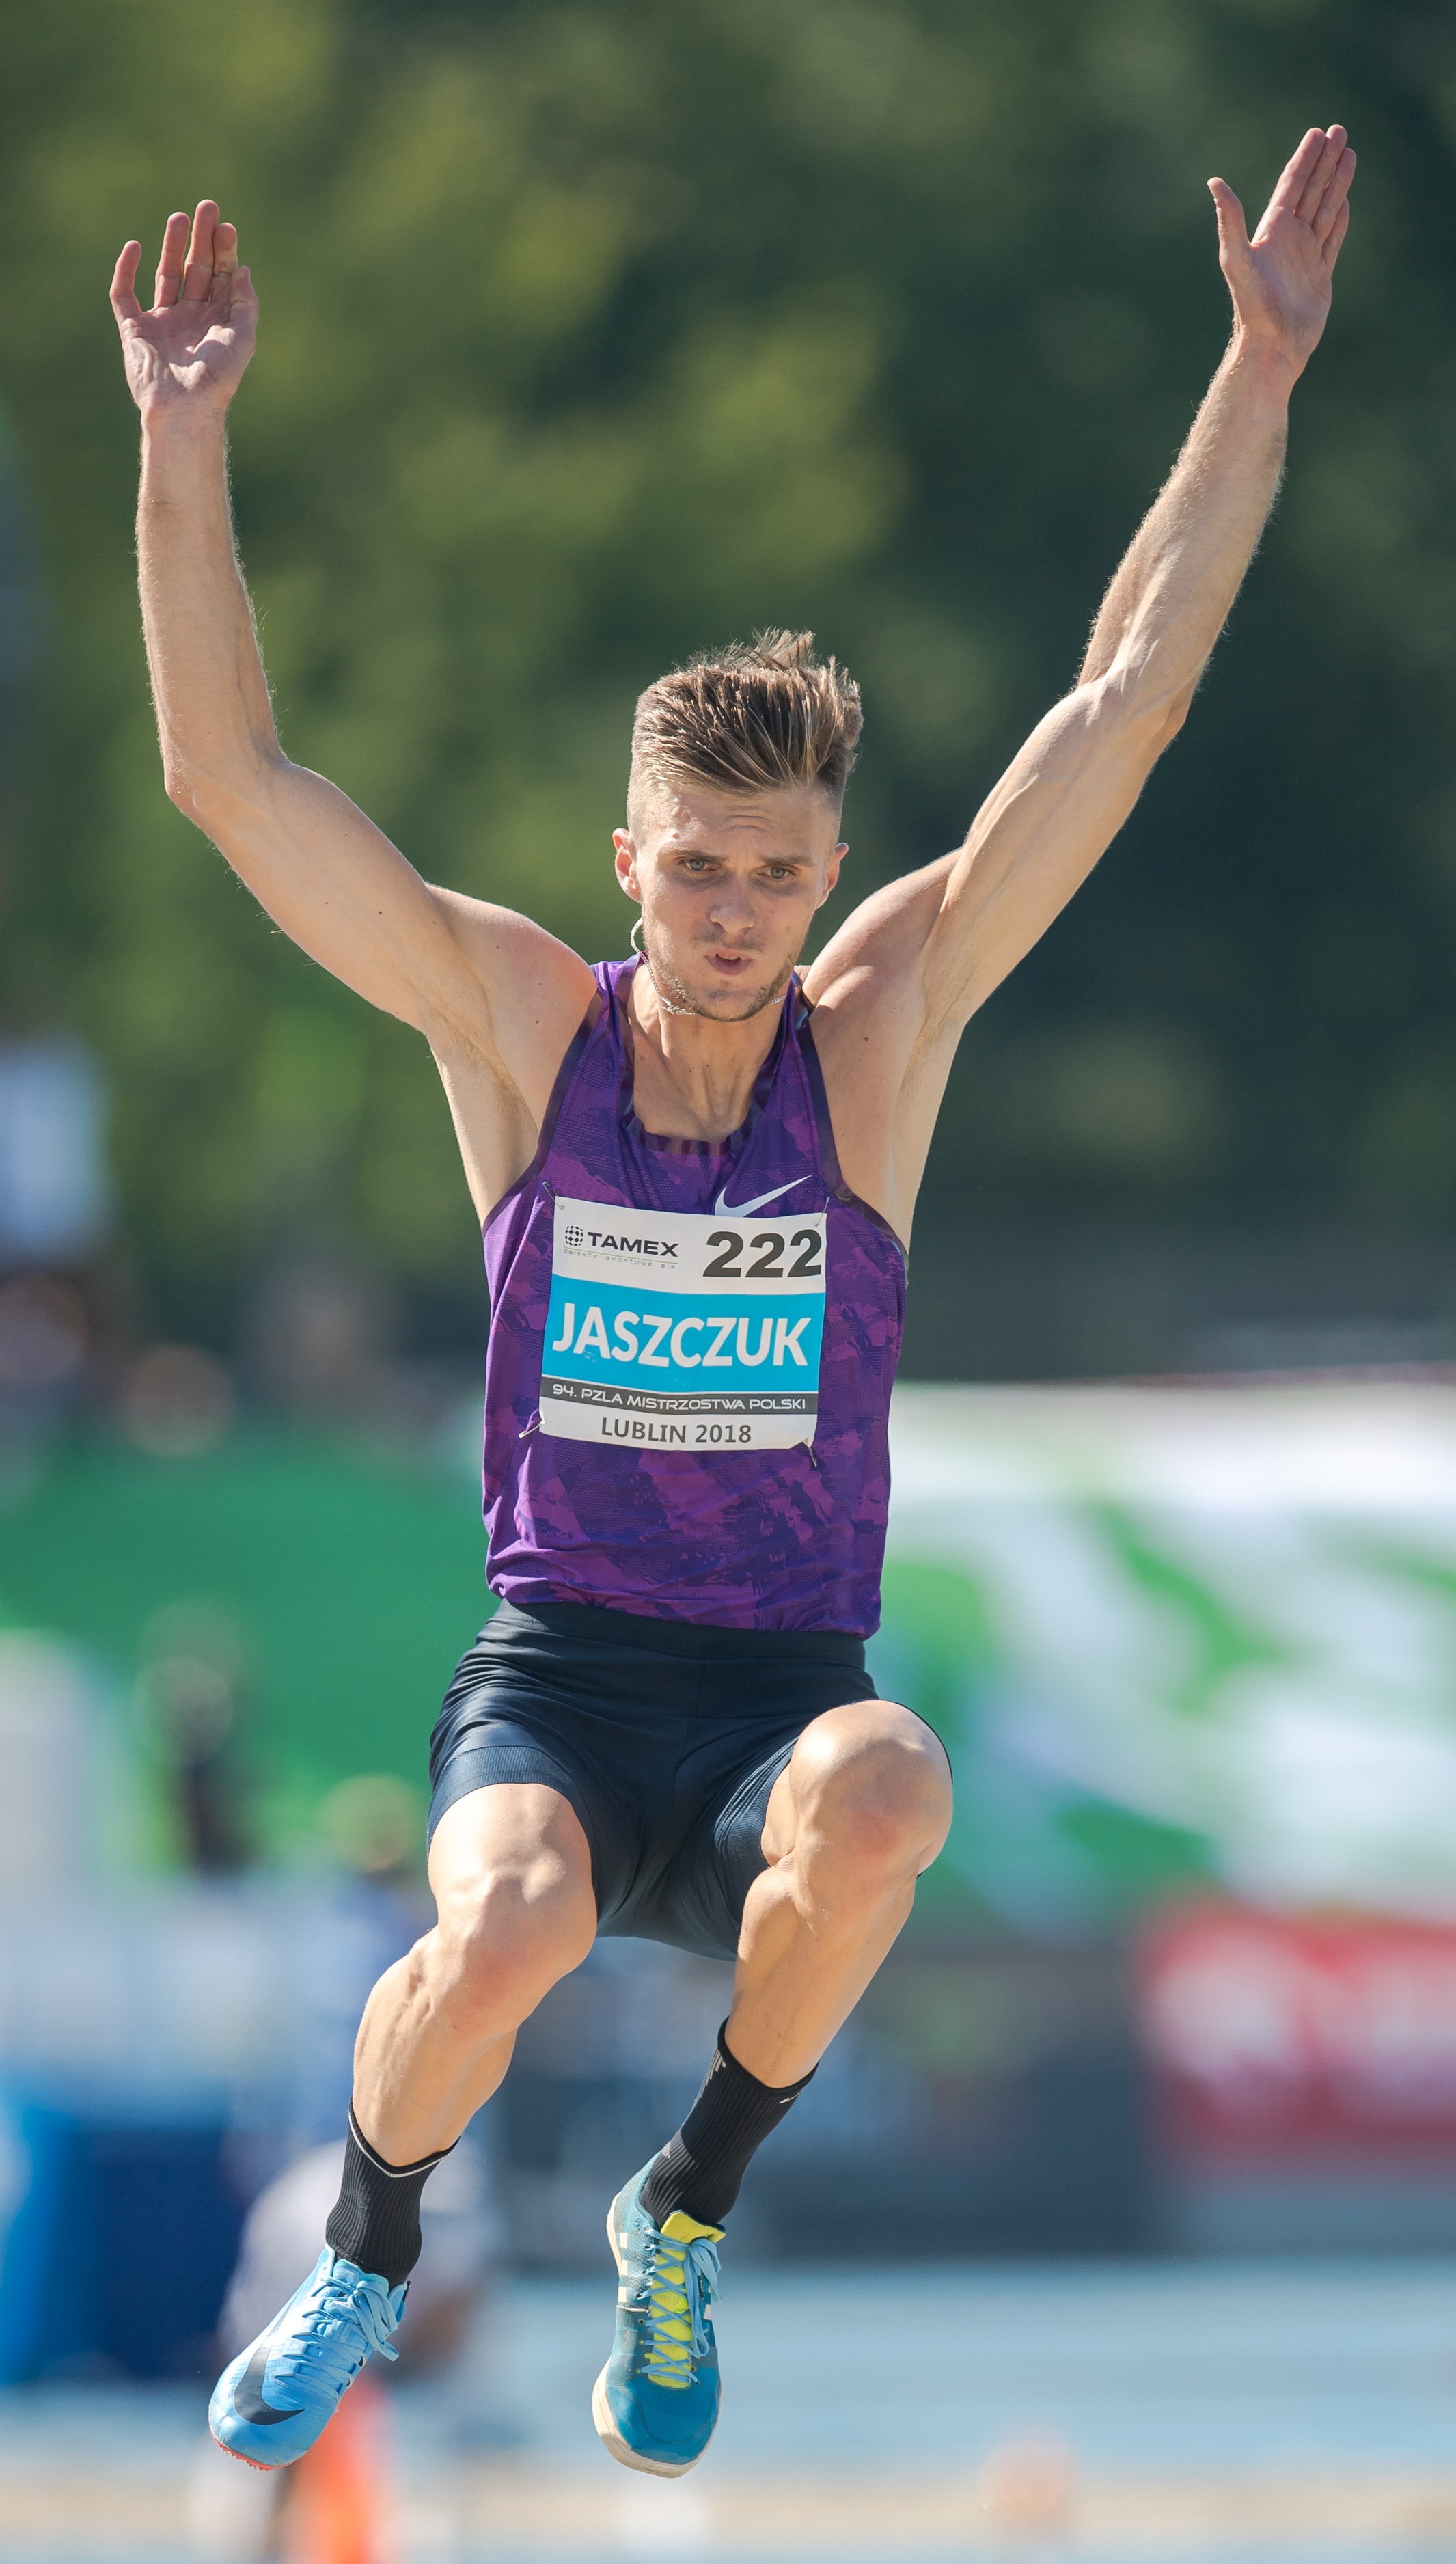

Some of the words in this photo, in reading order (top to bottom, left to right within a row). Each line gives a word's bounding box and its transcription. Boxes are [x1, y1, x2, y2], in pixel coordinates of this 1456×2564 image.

[588, 1231, 679, 1257] TAMEX
[702, 1229, 822, 1278] 222
[552, 1303, 812, 1367] JASZCZUK
[553, 1383, 577, 1397] 94.
[581, 1388, 623, 1405] PZLA
[627, 1395, 745, 1410] MISTRZOSTWA
[749, 1398, 806, 1410] POLSKI
[601, 1417, 686, 1443] LUBLIN
[695, 1424, 752, 1443] 2018
